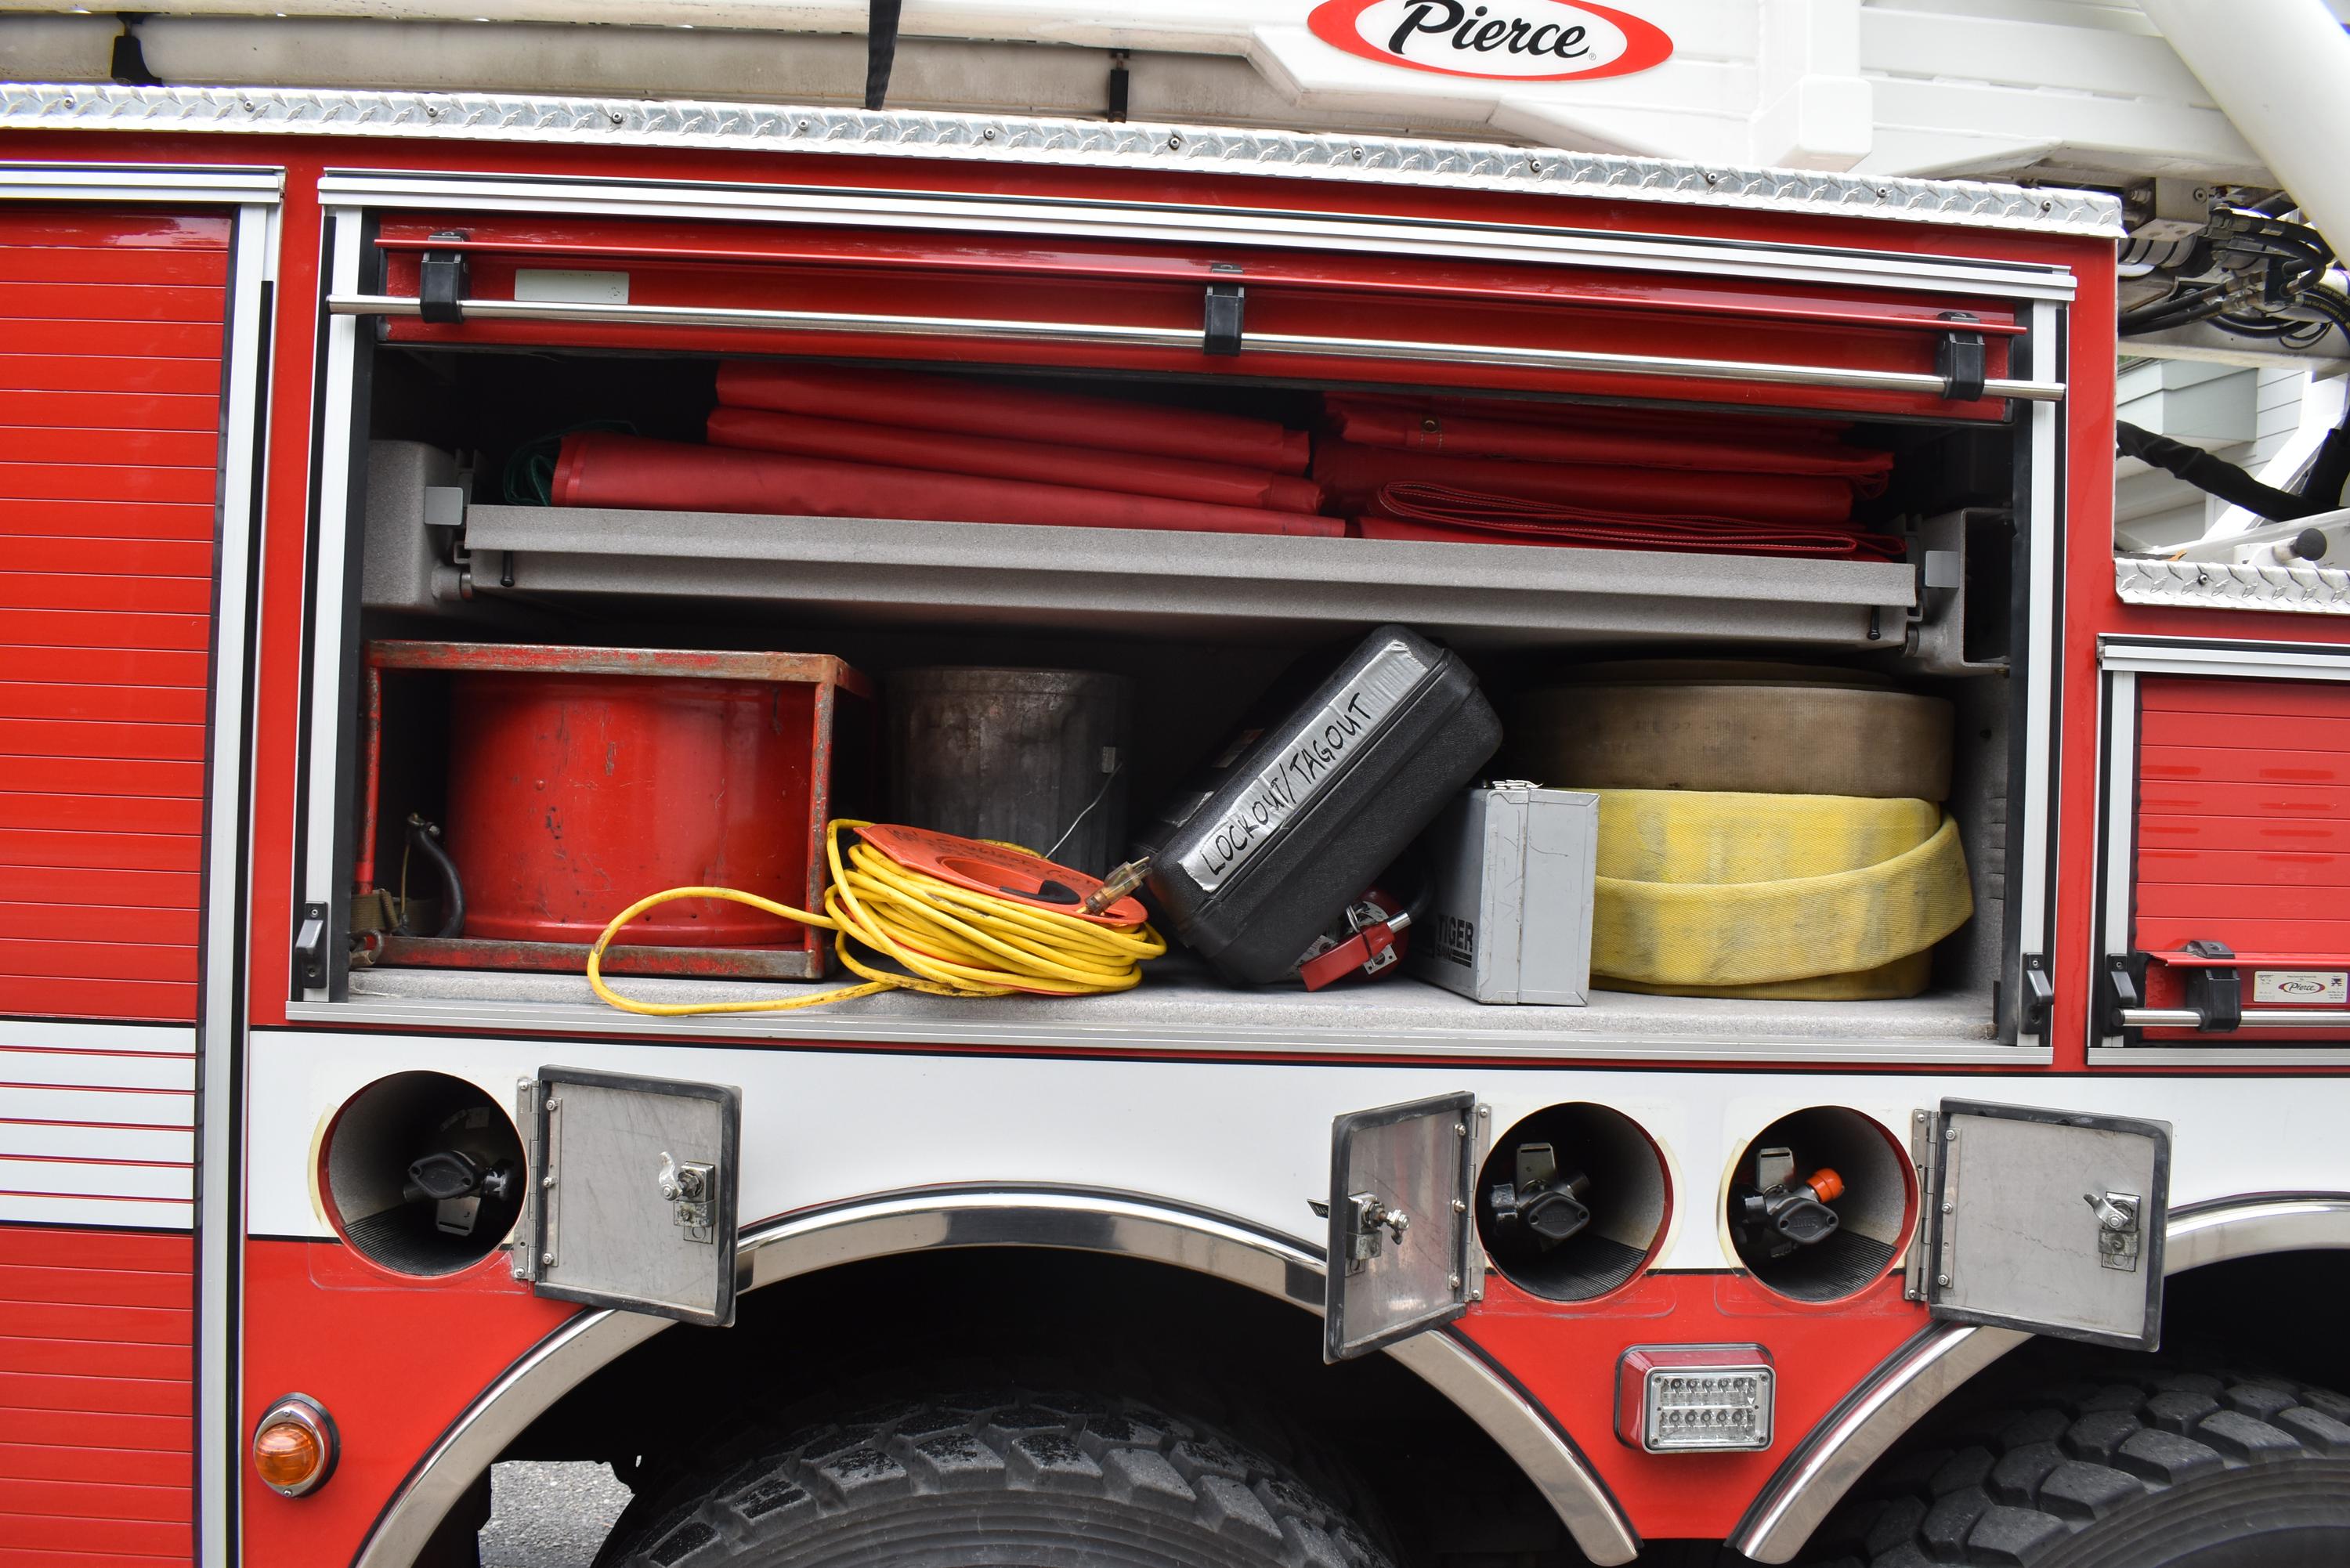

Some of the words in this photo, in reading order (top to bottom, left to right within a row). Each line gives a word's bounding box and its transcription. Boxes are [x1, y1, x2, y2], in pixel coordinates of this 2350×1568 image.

[1388, 0, 1590, 59] Pierce
[1202, 692, 1372, 876] LOCKOUT/TAGOUT
[1437, 914, 1473, 952] TIGER
[2288, 982, 2316, 992] Pierce
